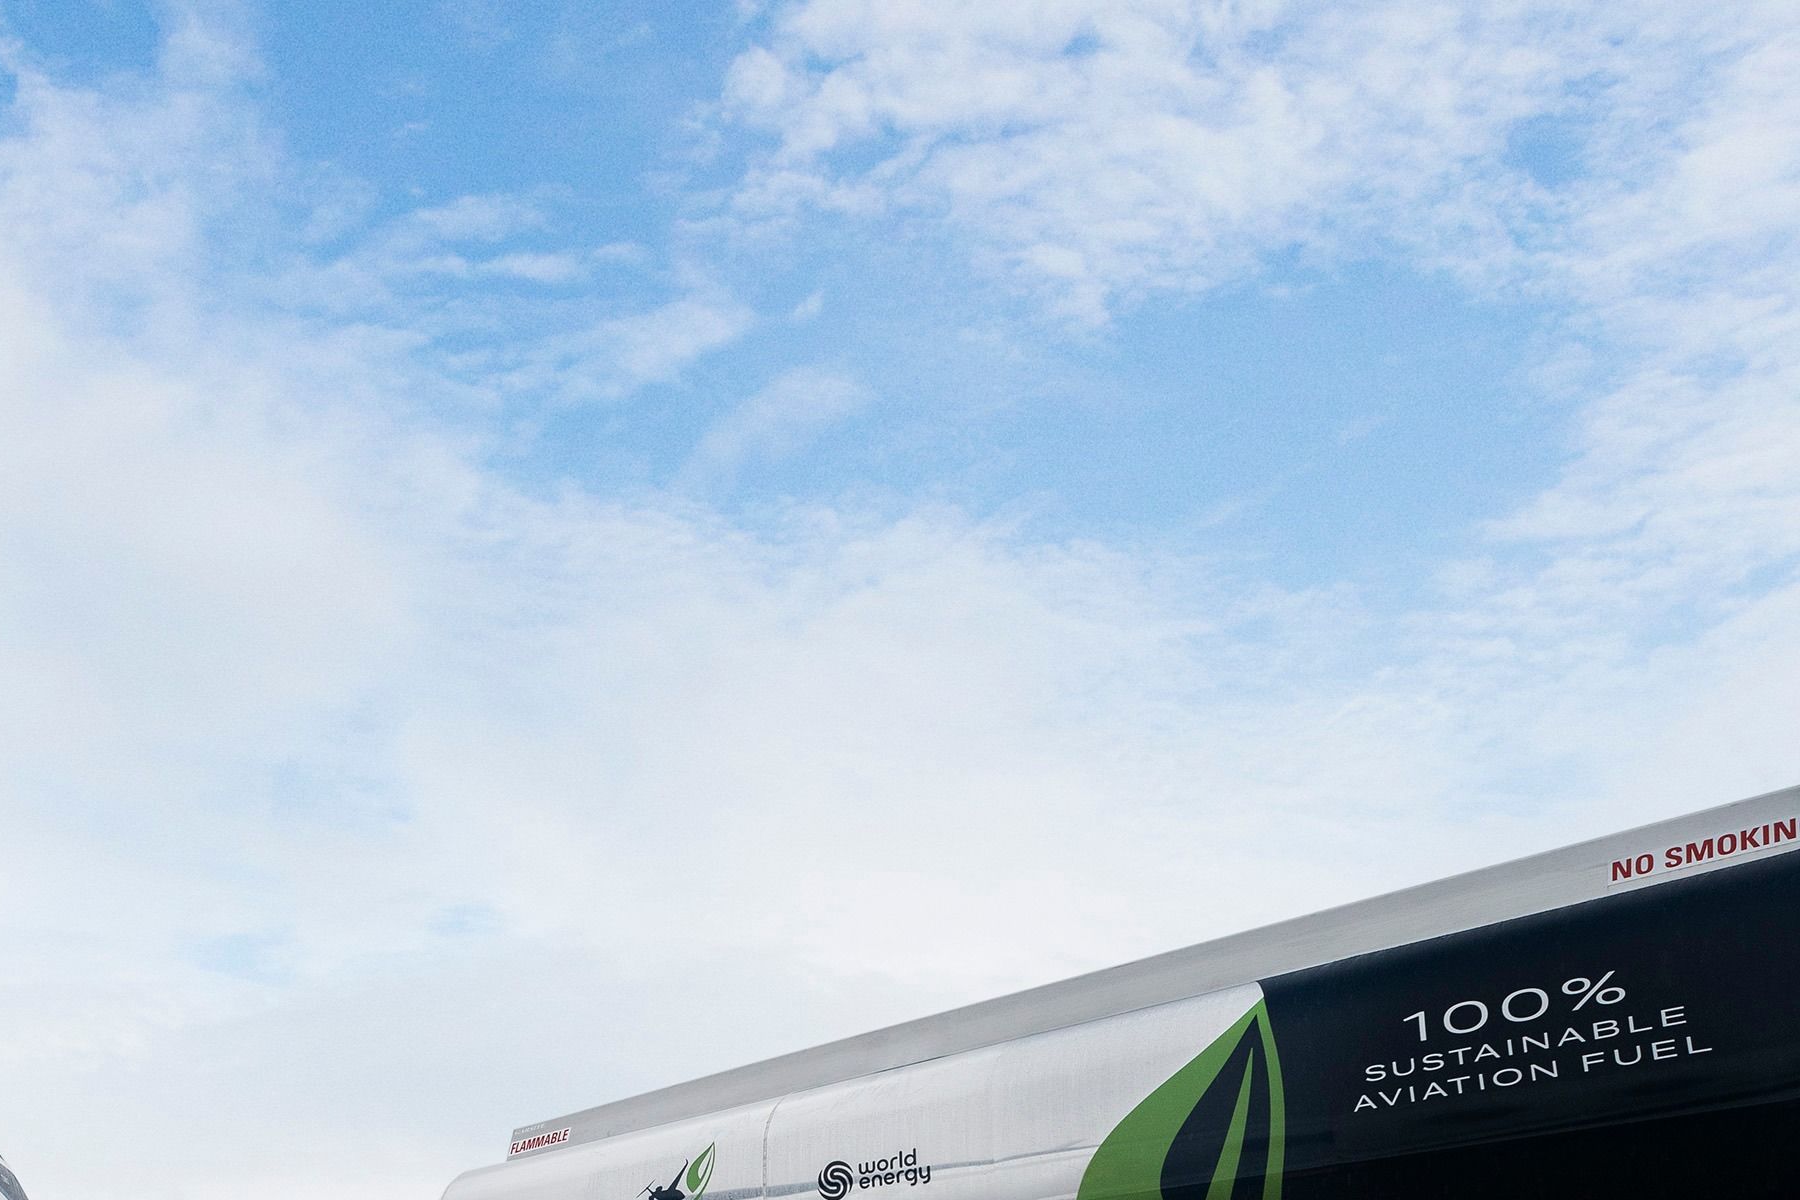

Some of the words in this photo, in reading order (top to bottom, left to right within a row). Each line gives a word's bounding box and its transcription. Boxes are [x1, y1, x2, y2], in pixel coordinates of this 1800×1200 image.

[1612, 854, 1654, 881] NO
[1665, 818, 1800, 868] SMOKIN
[1403, 970, 1626, 1042] 100%
[1354, 1060, 1558, 1112] AVIATION
[1582, 1036, 1712, 1073] FUEL
[1365, 1006, 1687, 1082] SUSTAINABLE
[510, 1129, 569, 1154] FLAMMABLE
[858, 1148, 917, 1175] world
[859, 1165, 931, 1189] energy
